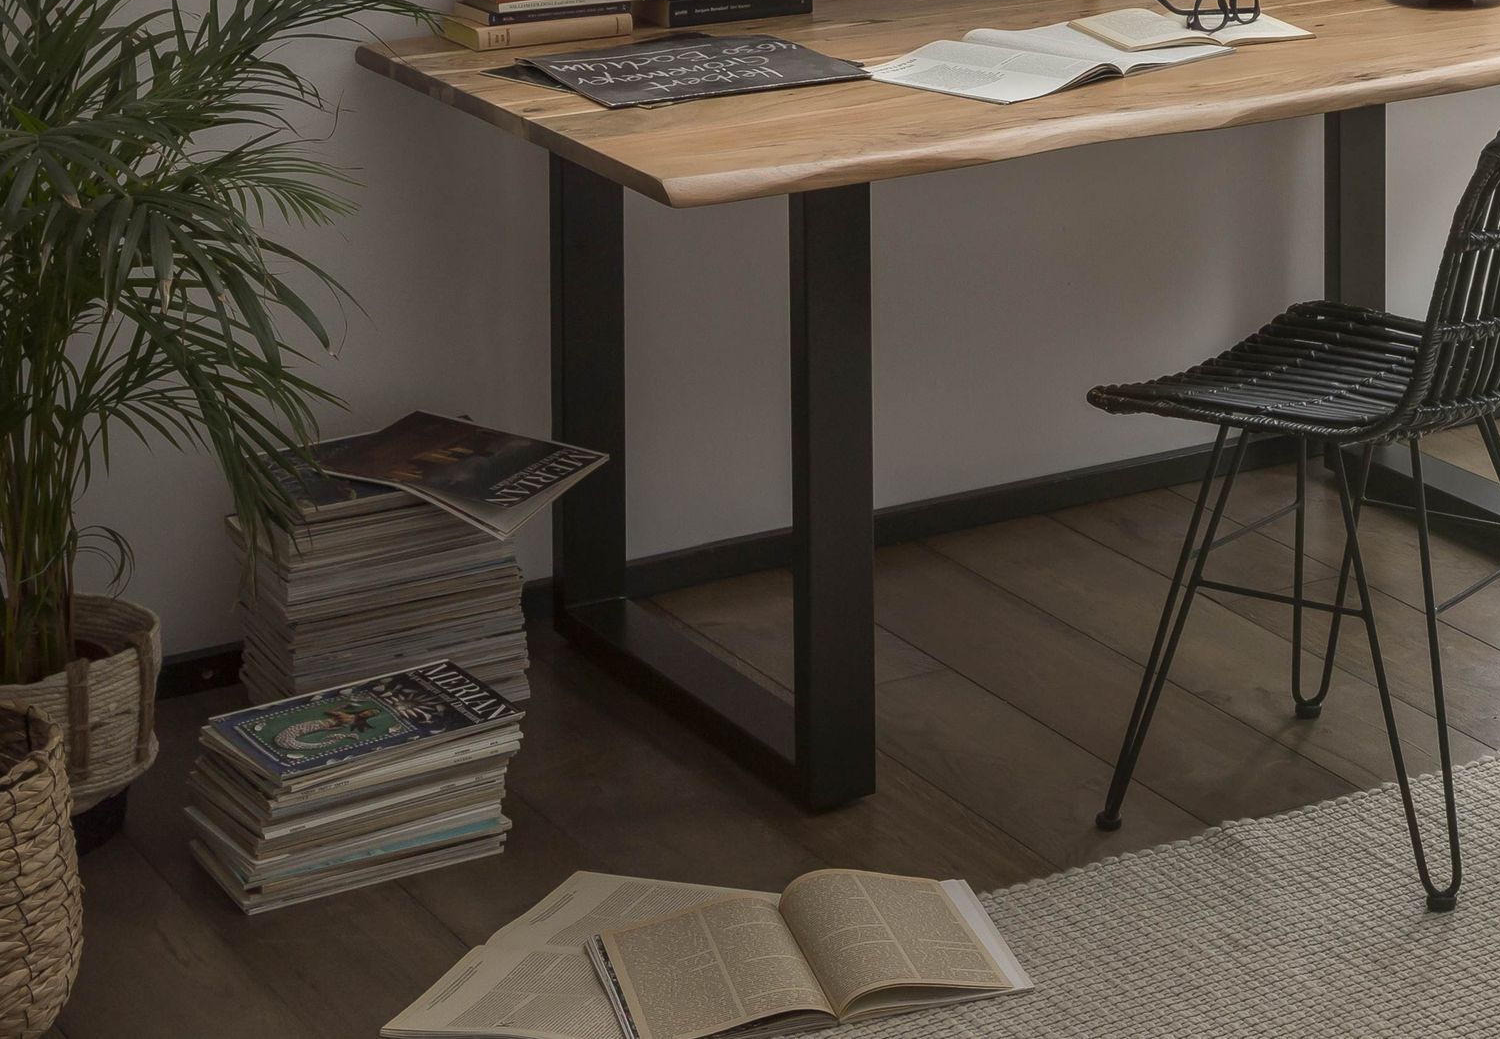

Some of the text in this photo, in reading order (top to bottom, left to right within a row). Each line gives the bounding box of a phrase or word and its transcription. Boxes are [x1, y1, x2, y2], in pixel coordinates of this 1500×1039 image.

[550, 42, 798, 73] 4630 Bochum
[577, 56, 770, 85] Grönemeyer
[645, 66, 784, 93] Herbert
[485, 449, 599, 507] MERIAN
[418, 663, 516, 720] MERIAN
